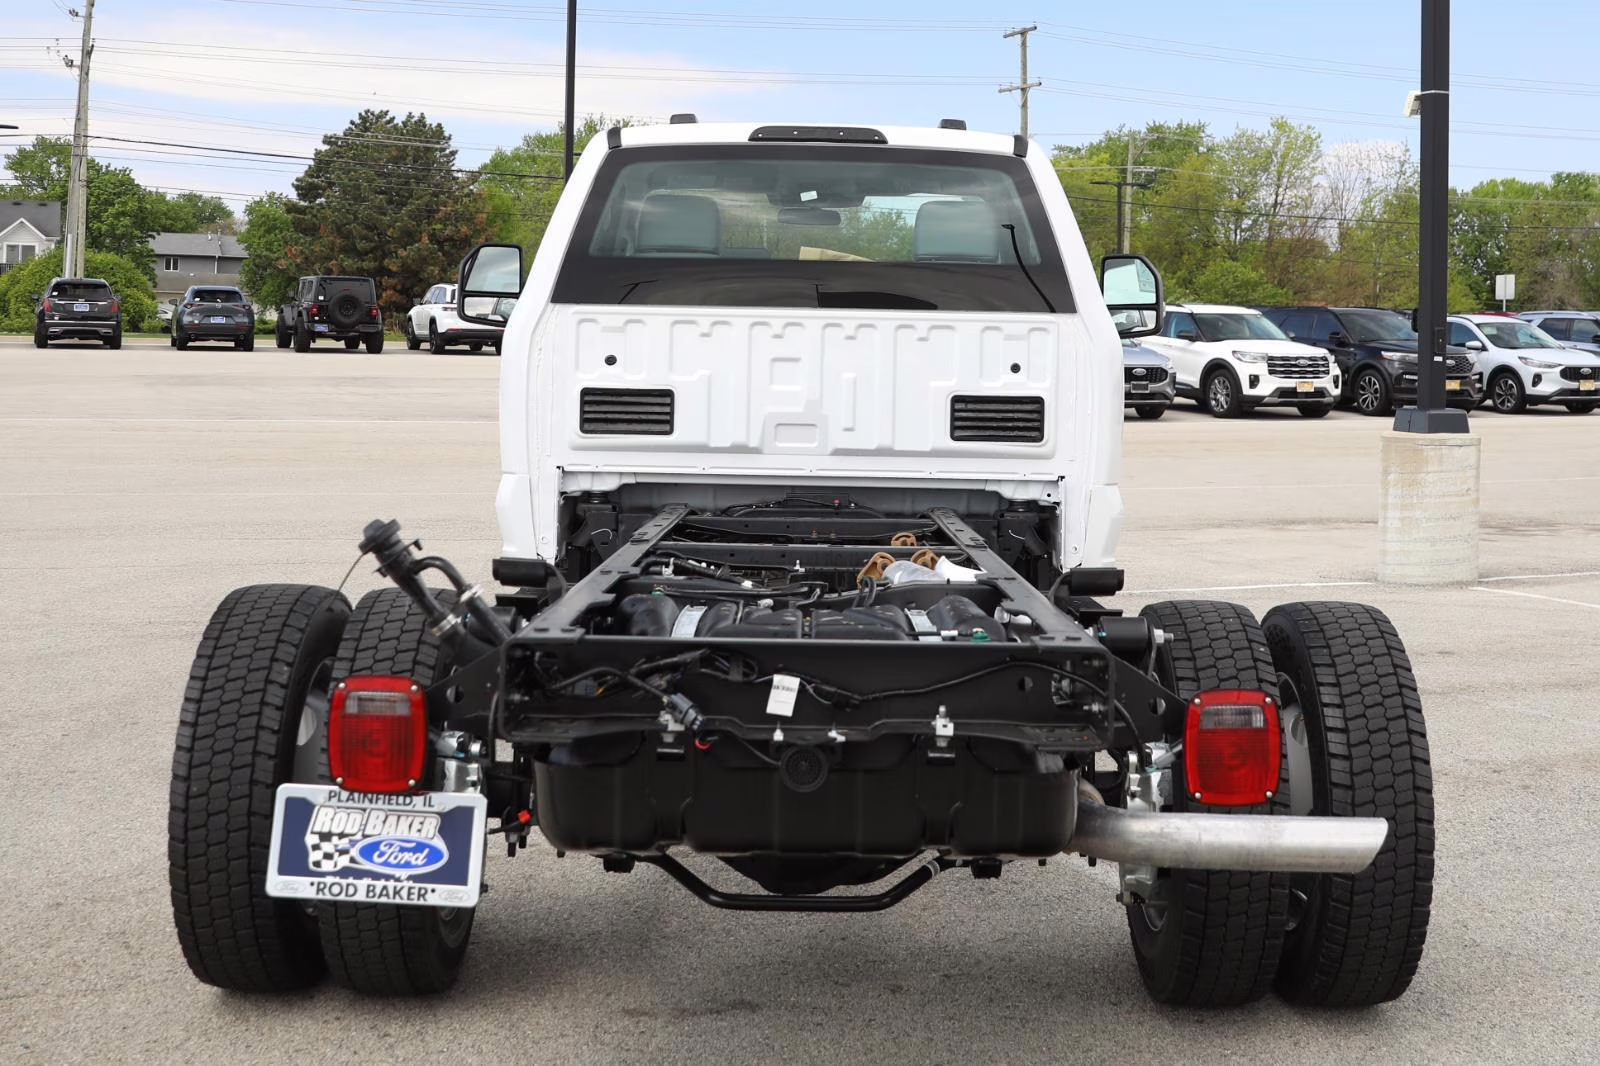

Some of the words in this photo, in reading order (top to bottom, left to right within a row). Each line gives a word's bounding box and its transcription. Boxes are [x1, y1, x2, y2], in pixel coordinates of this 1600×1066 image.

[327, 791, 416, 808] PLAINFIELD,
[423, 795, 435, 808] IL
[312, 806, 363, 835] ROD
[364, 809, 438, 840] BAKER
[372, 840, 430, 866] Ford
